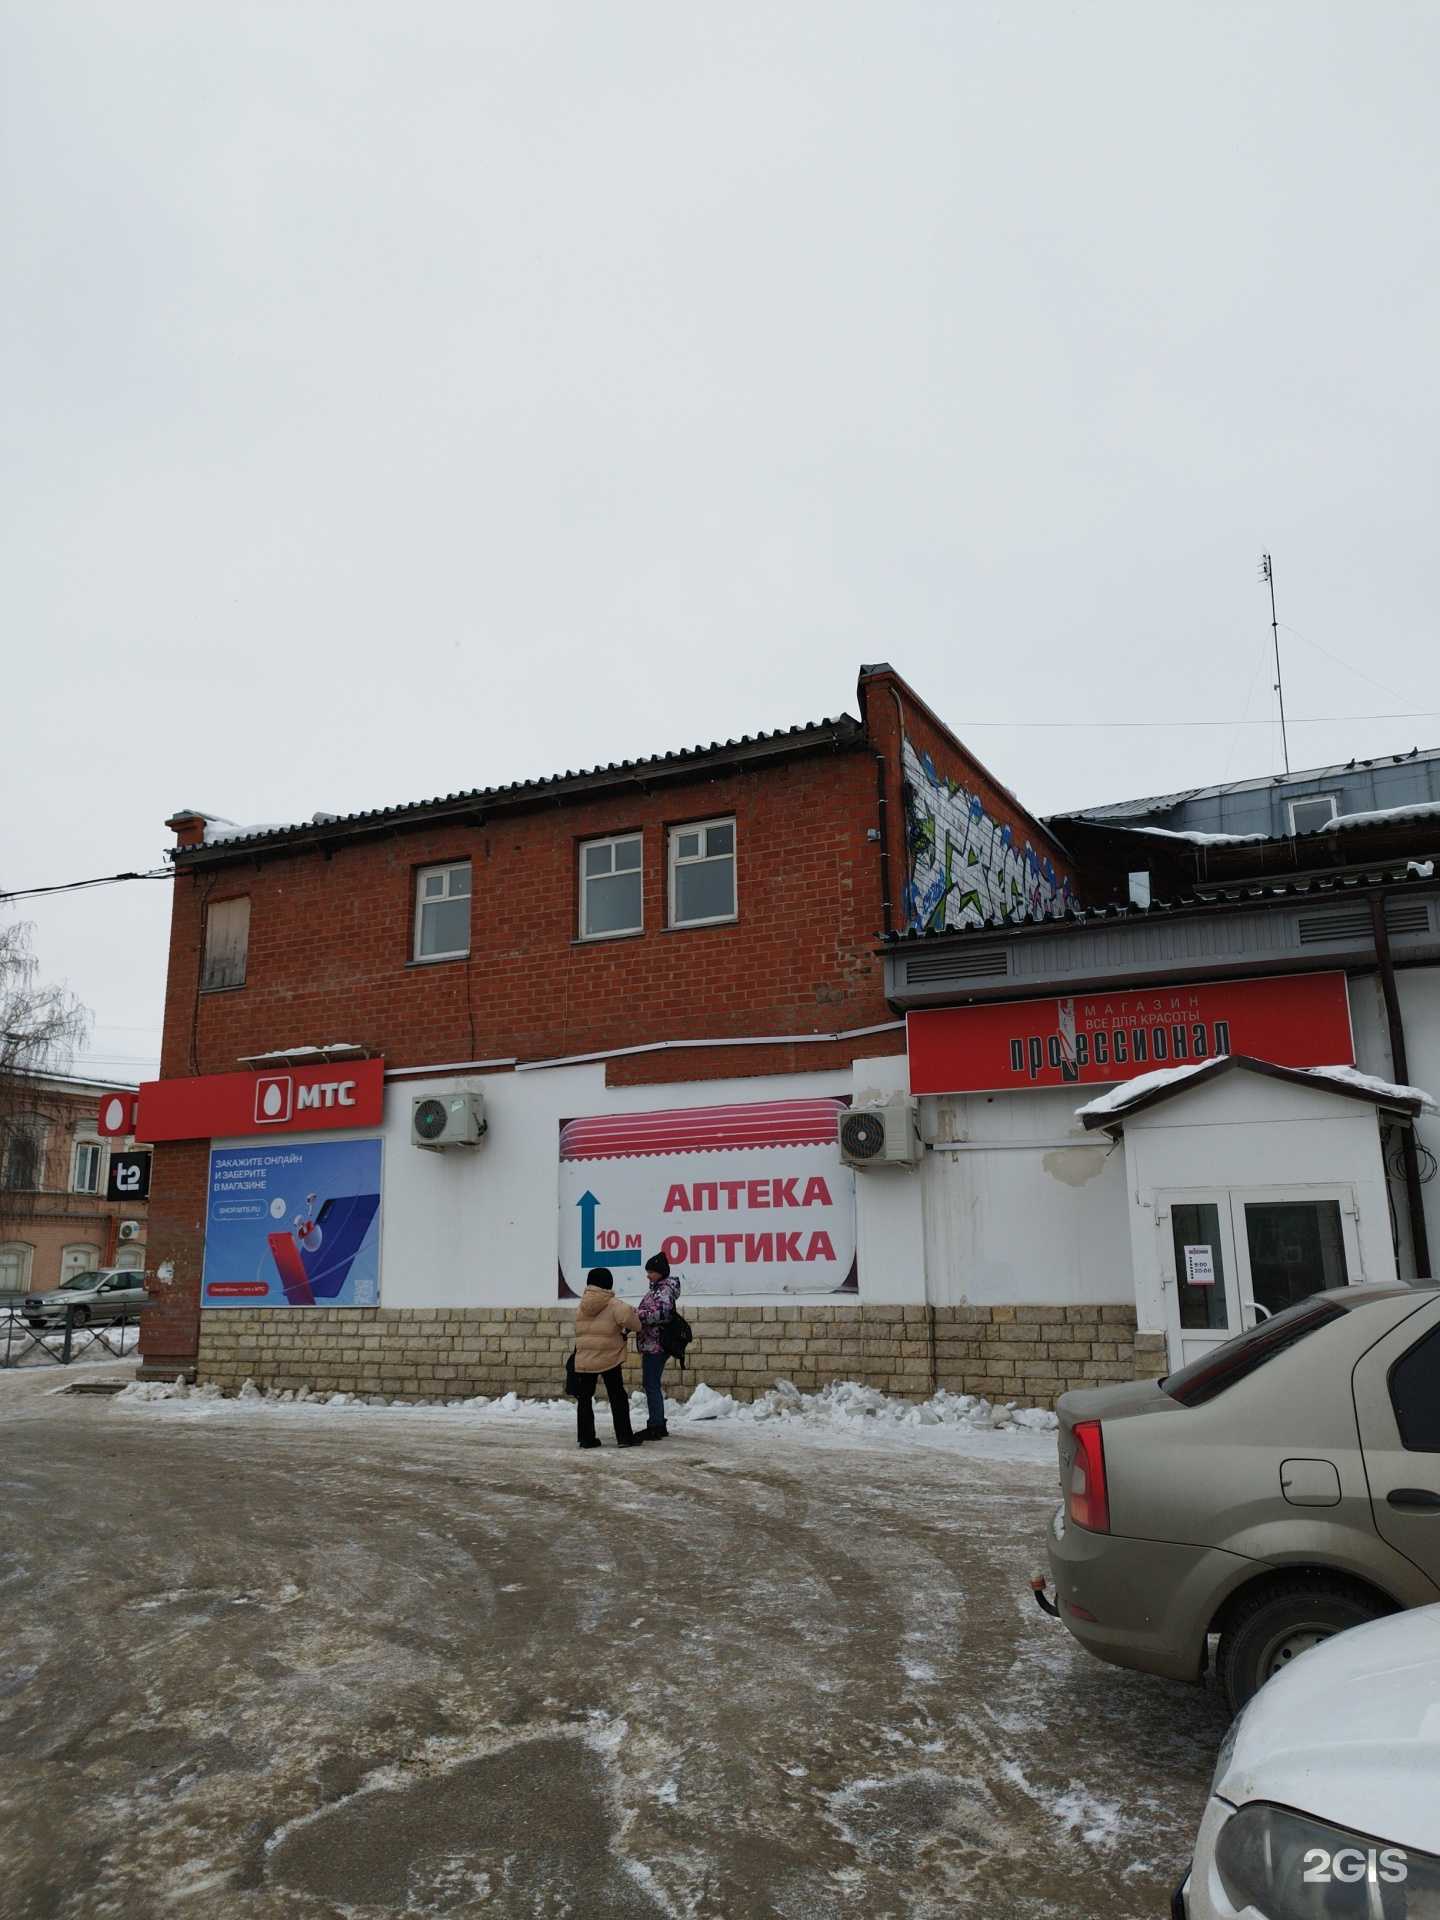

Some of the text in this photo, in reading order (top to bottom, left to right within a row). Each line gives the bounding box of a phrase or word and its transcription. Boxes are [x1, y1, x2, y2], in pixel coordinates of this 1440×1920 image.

[1085, 997, 1200, 1017] МАГАЗИН
[1086, 1011, 1200, 1030] ВСЕ ДЛЯ КРАСОТЫ
[296, 1080, 356, 1110] МТС
[215, 1153, 303, 1169] ЗАКАЖИТЕ ОНЛАЙН
[116, 1162, 141, 1191] t2
[215, 1169, 267, 1180] И ЗАБЕРИТЕ
[214, 1180, 267, 1192] В МАГАЗИНЕ
[663, 1176, 833, 1212] АПТЕКА
[597, 1230, 620, 1250] 10
[661, 1230, 837, 1265] ОПТИКА
